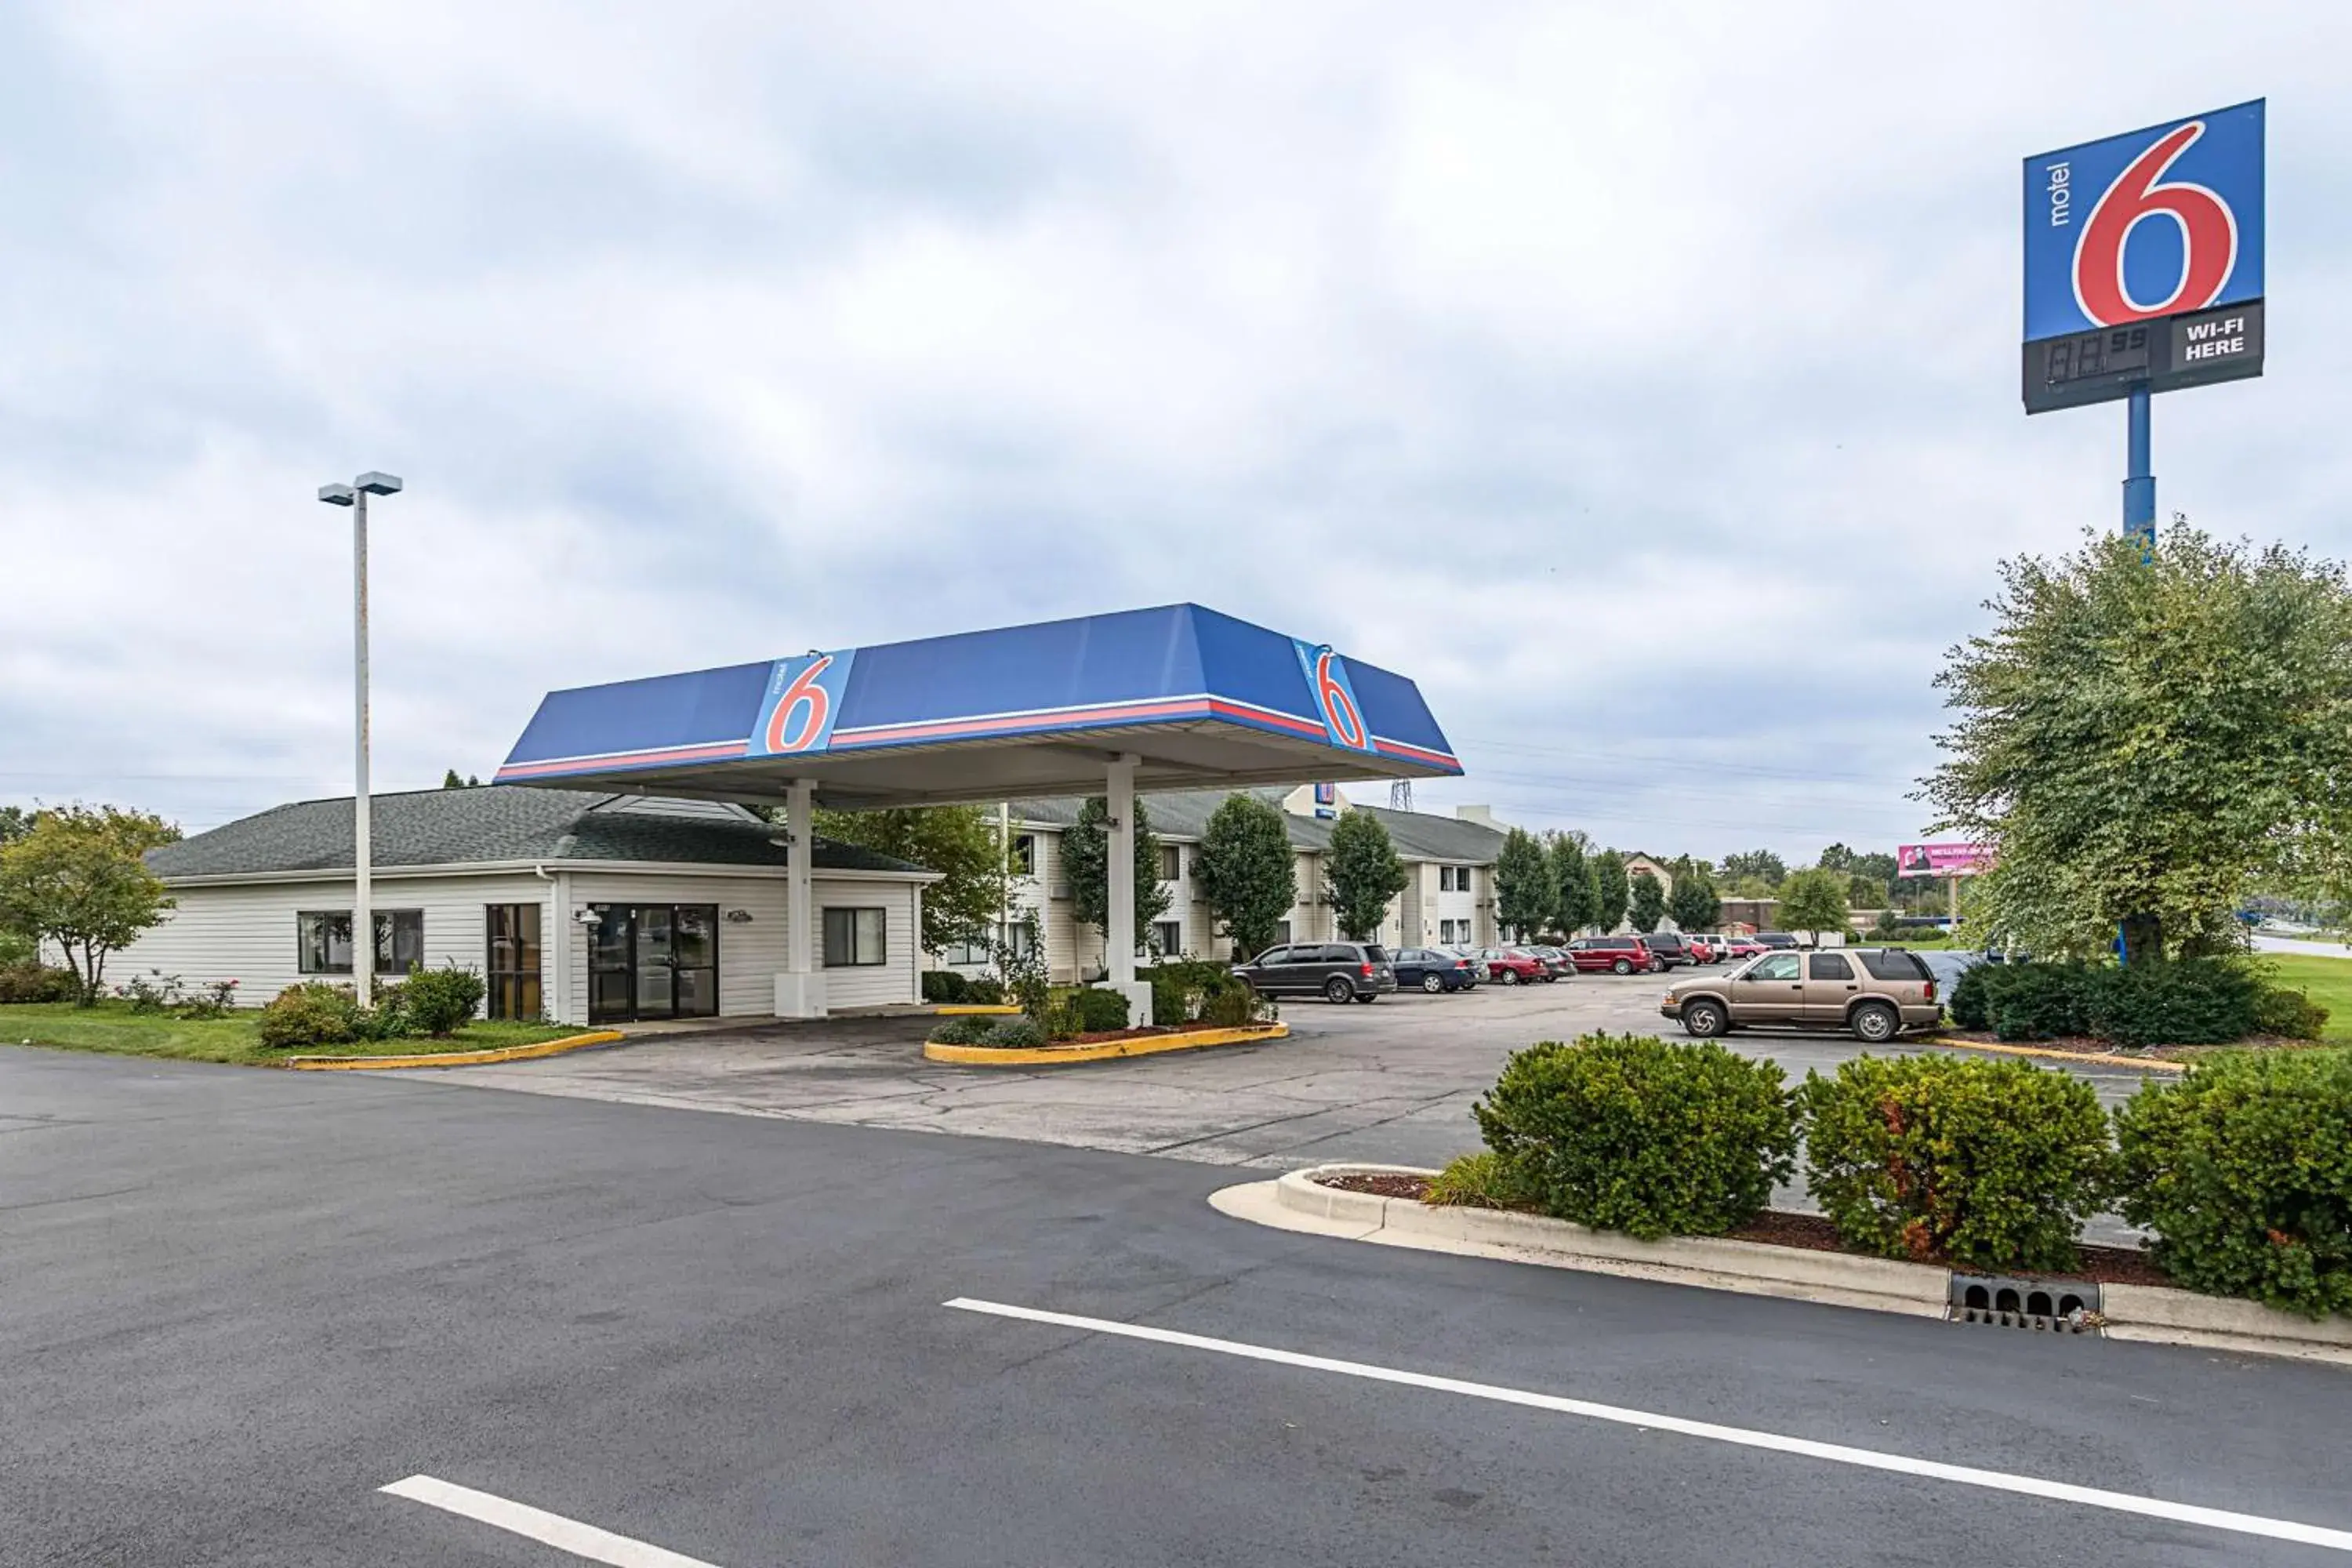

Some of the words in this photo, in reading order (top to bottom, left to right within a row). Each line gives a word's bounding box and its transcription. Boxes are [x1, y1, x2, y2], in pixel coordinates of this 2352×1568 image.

[2046, 162, 2070, 226] motel
[2072, 121, 2238, 328] 6
[2186, 336, 2245, 361] HERE
[2187, 317, 2245, 341] WI-FI
[765, 655, 834, 753] 6
[1317, 652, 1367, 750] 6
